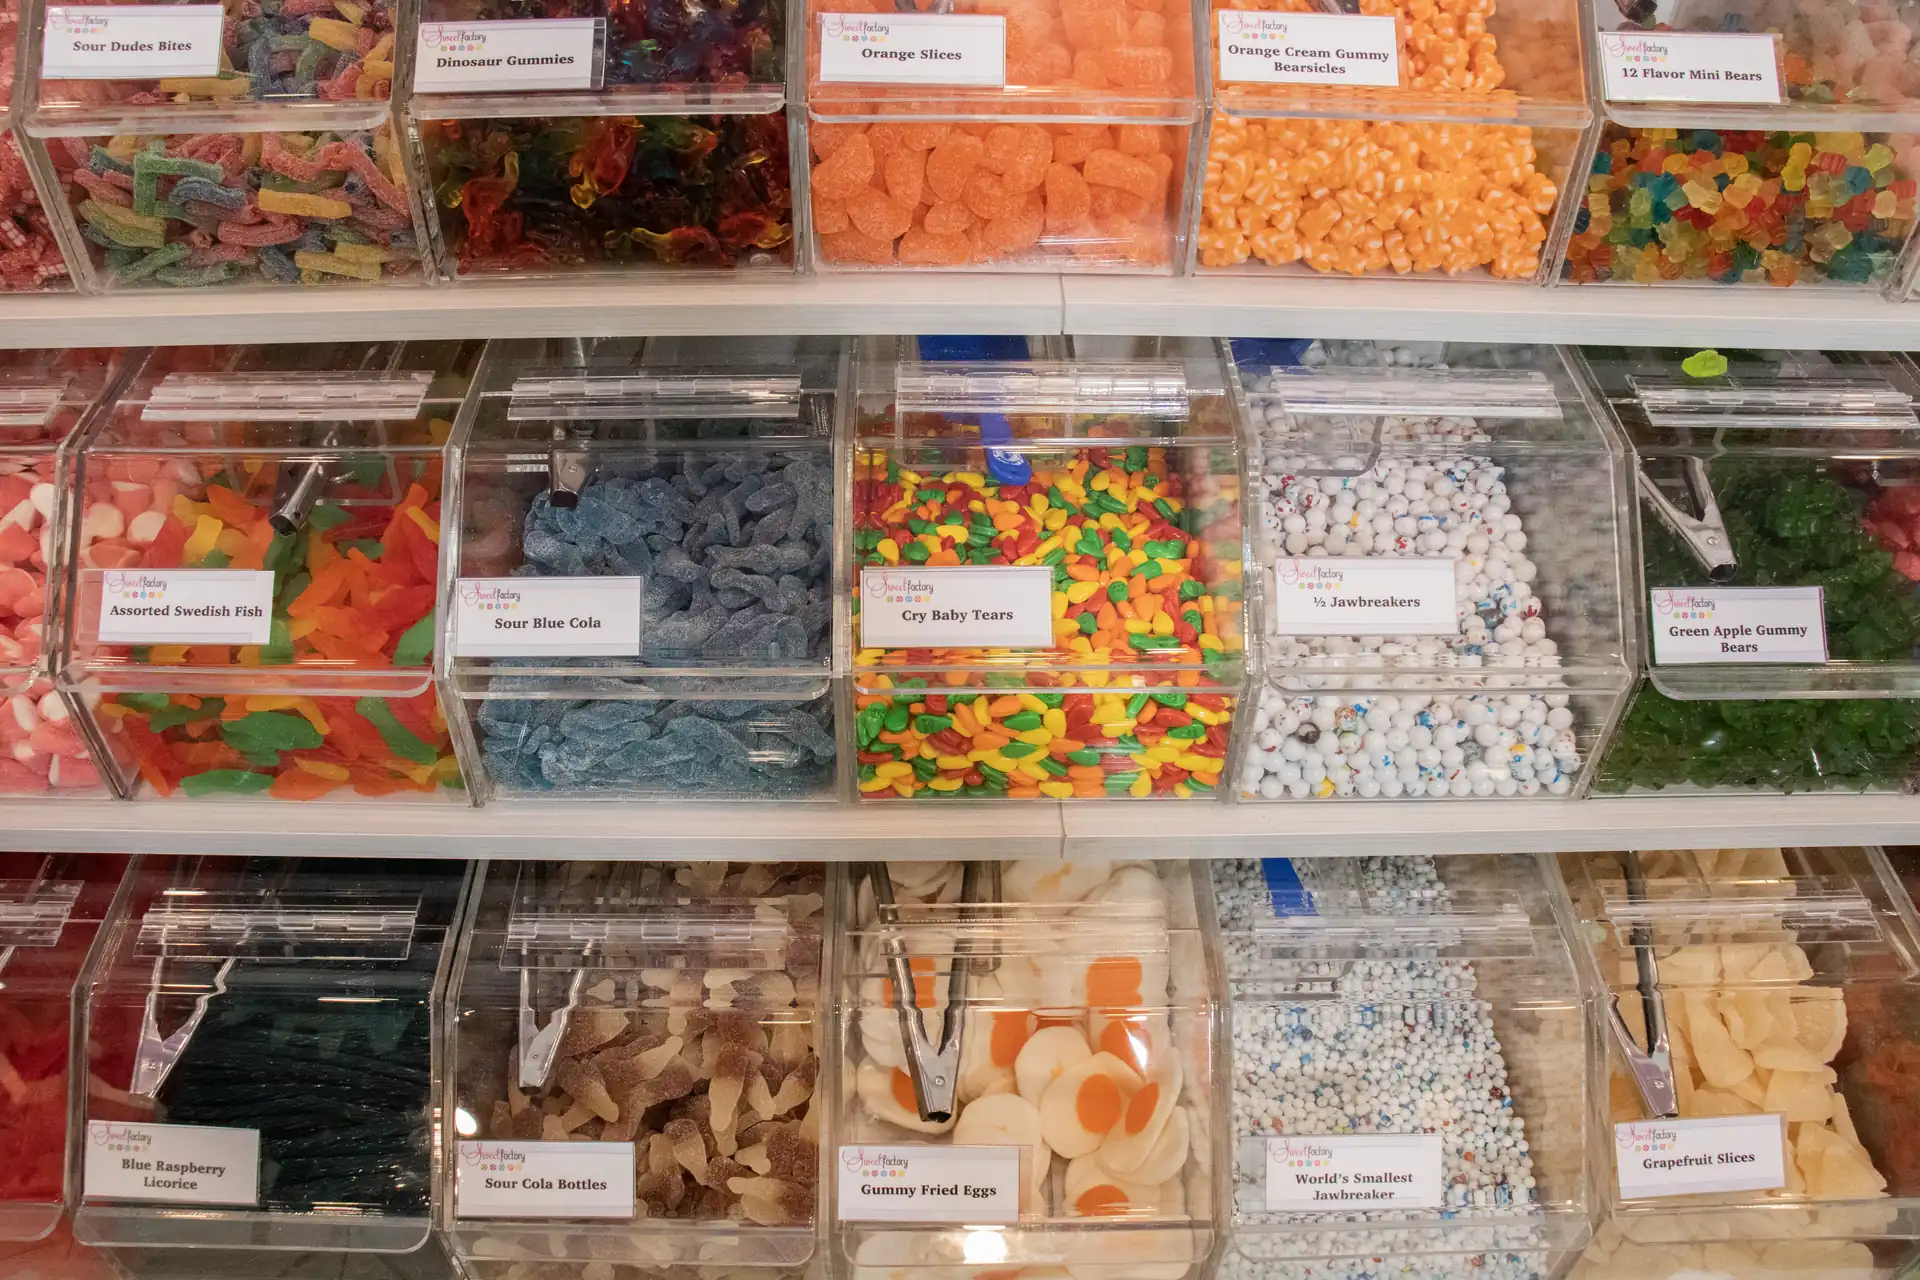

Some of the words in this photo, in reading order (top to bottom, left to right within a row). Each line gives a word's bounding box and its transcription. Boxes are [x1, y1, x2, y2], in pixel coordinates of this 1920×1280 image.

[73, 41, 107, 52] Sour
[110, 41, 154, 52] Dudes
[157, 40, 193, 52] Bites
[1227, 44, 1281, 58] Orange
[1284, 46, 1331, 58] Cream
[1335, 48, 1391, 62] Gummy
[436, 57, 503, 69] Dinosaur
[506, 54, 575, 68] Gummies
[861, 48, 916, 62] Orange
[920, 48, 963, 61] Slices
[1273, 61, 1347, 74] Bearsicles
[1621, 67, 1638, 78] 12
[1641, 67, 1685, 79] Flavor
[1688, 69, 1720, 80] Mini
[1724, 70, 1762, 82] Bears
[1330, 596, 1421, 609] Jawbreakers
[109, 604, 171, 617] Assorted
[173, 605, 231, 618] Swedish
[233, 605, 263, 618] Fish
[901, 610, 928, 623] Cry
[931, 609, 969, 622] Baby
[971, 609, 1014, 621] Tears
[494, 618, 529, 630] Sour
[532, 617, 565, 629] Blue
[568, 617, 602, 630] Cola
[1669, 625, 1710, 638] Green
[1713, 625, 1753, 640] Apple
[1756, 624, 1808, 639] Gummy
[1720, 641, 1759, 654] Bears
[121, 1157, 152, 1170] Blue
[155, 1160, 226, 1177] Raspberry
[1642, 1154, 1713, 1170] Grapefruit
[1717, 1151, 1755, 1164] Slices
[143, 1176, 199, 1190] Licorice
[484, 1177, 519, 1189] Sour
[521, 1177, 554, 1189] Cola
[557, 1178, 608, 1190] Bottles
[1294, 1173, 1349, 1186] World's
[1352, 1172, 1413, 1184] Smallest
[860, 1183, 917, 1198] Gummy
[920, 1184, 960, 1196] Fried
[963, 1185, 997, 1198] Eggs
[1311, 1189, 1395, 1202] Jawbreaker
